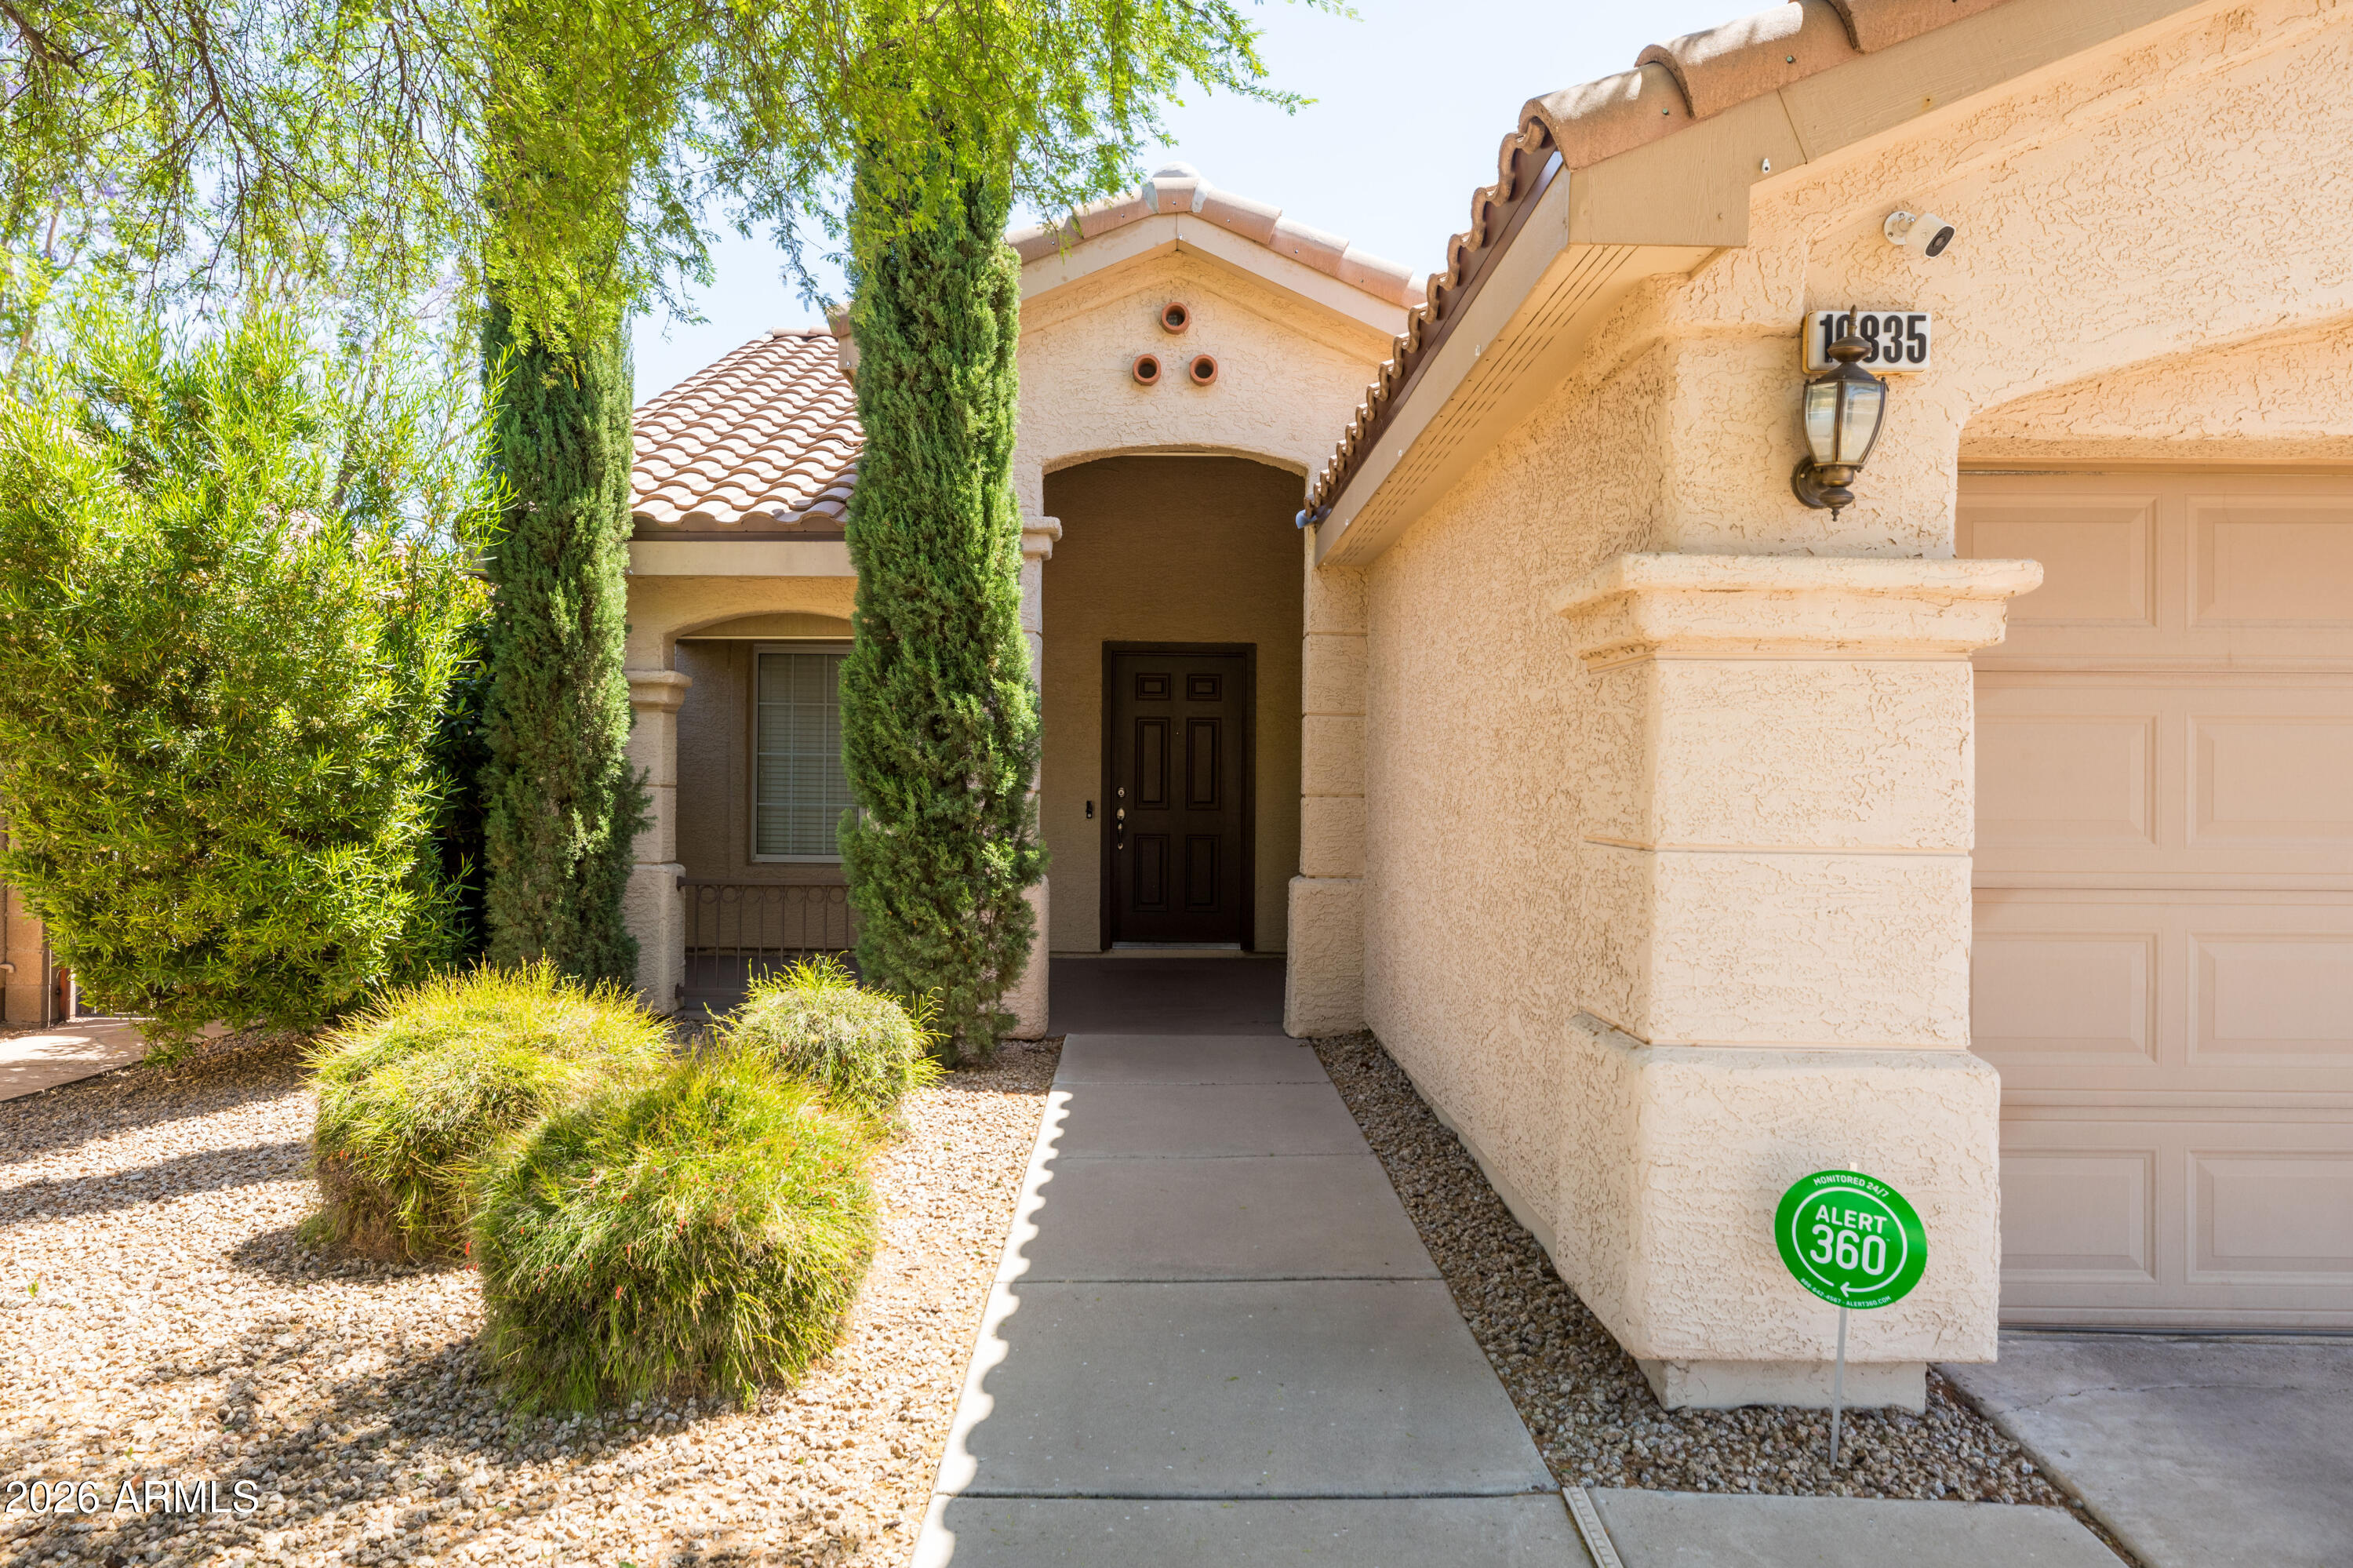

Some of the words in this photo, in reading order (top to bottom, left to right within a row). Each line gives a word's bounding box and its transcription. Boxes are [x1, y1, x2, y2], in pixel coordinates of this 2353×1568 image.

[1813, 1174, 1865, 1187] MONITORED
[1866, 1182, 1889, 1198] 24/7
[1815, 1204, 1888, 1234] ALERT
[1809, 1224, 1886, 1275] 360
[1846, 1295, 1891, 1307] ALERT360.COM
